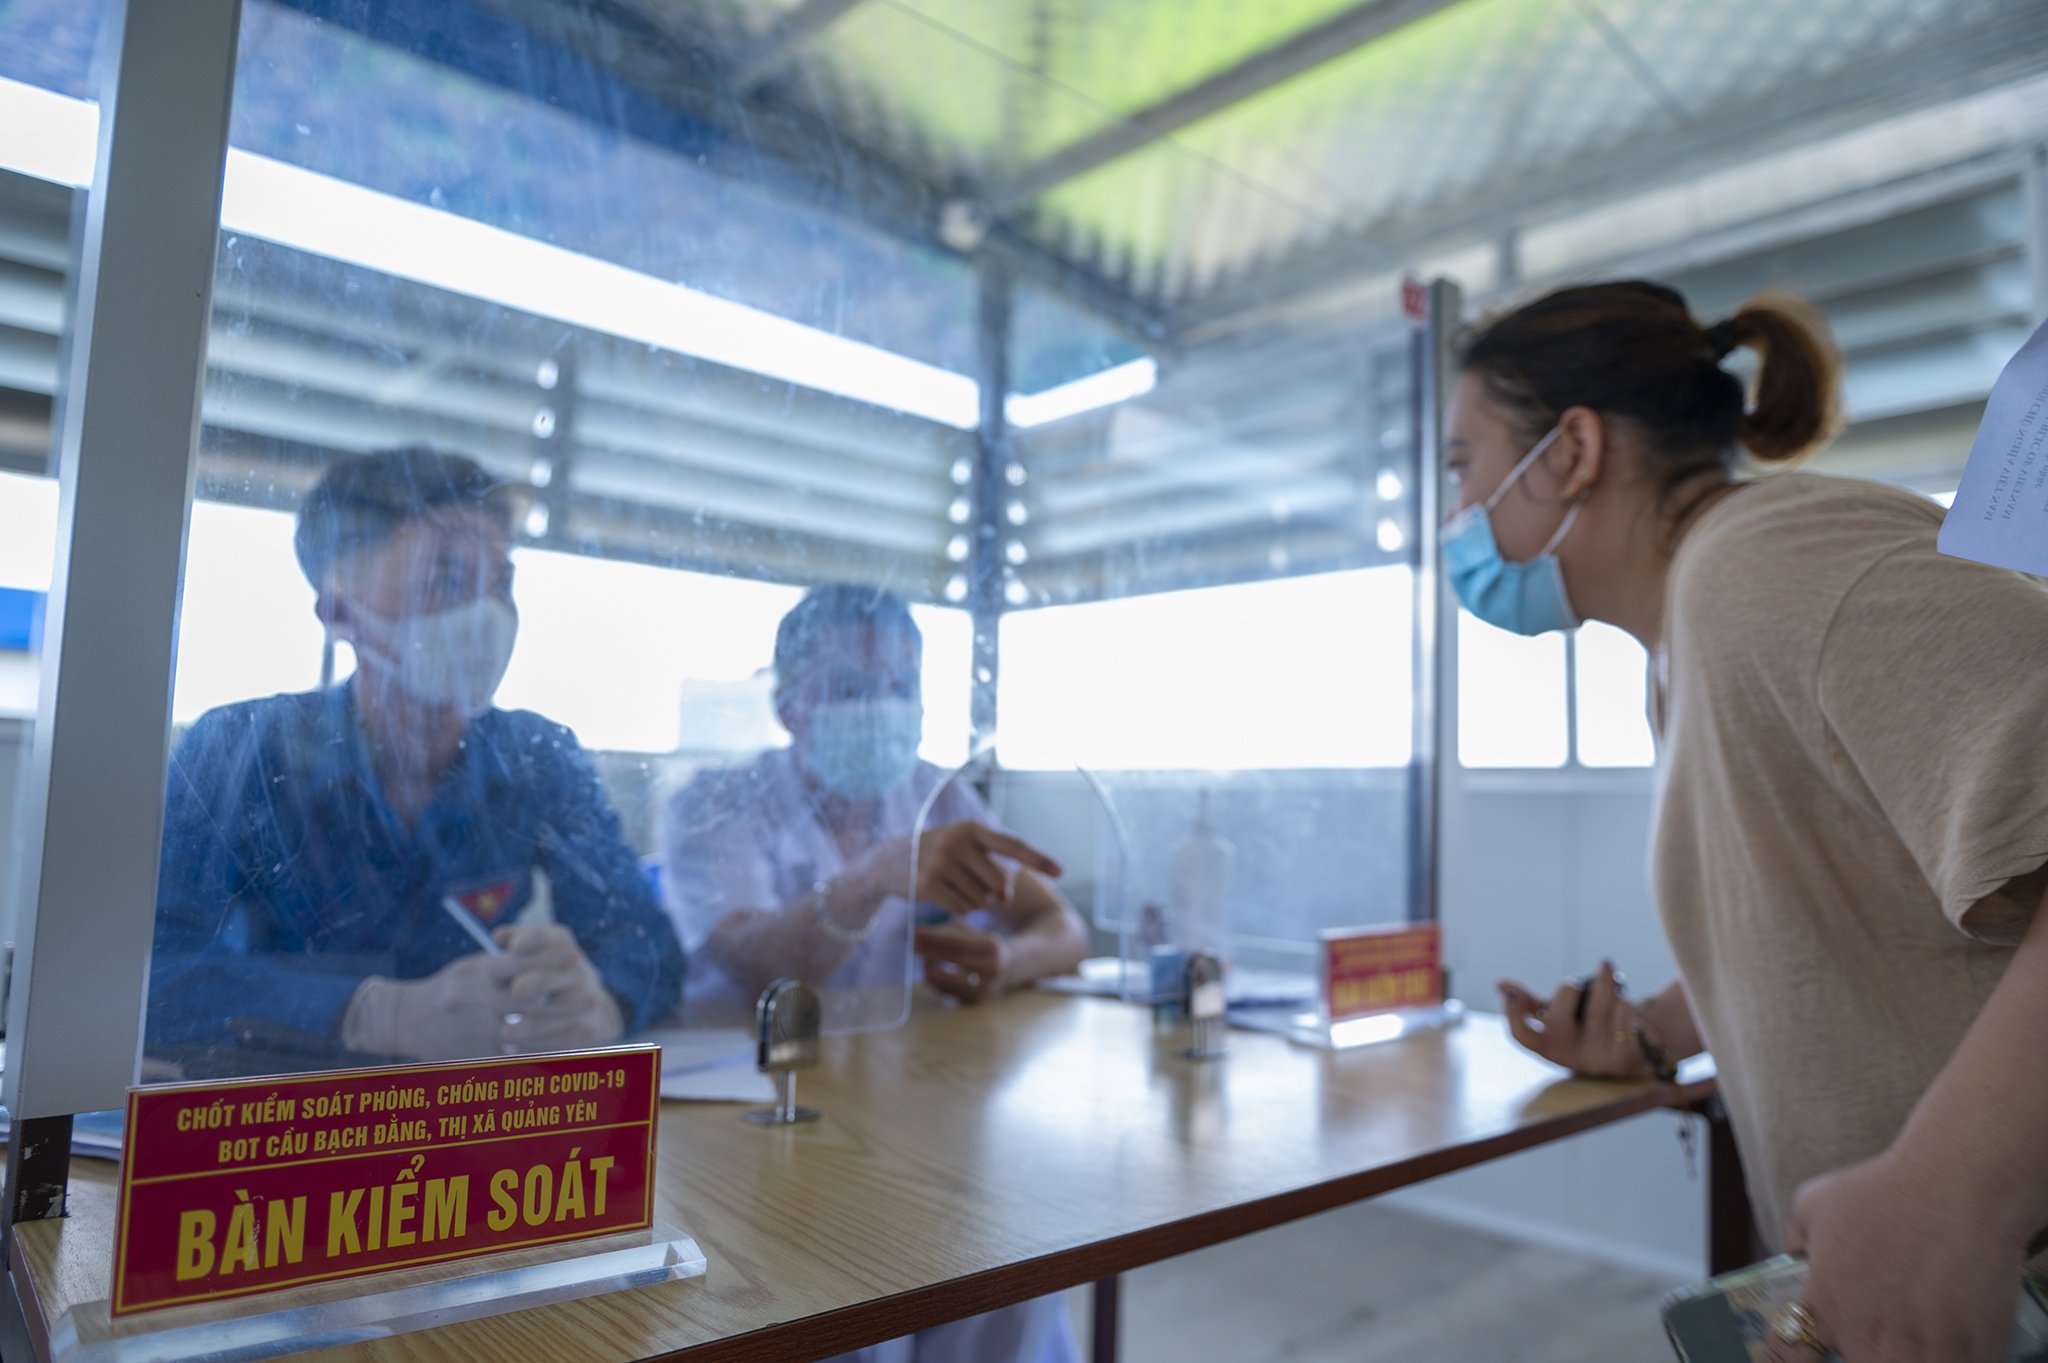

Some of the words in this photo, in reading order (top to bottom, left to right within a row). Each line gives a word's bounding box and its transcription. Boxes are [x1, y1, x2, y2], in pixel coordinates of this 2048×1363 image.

[177, 1098, 235, 1132] CHỐT
[240, 1092, 296, 1125] KIỂM
[301, 1090, 354, 1120] SOÁT
[359, 1085, 431, 1113] PHÒNG,
[437, 1076, 499, 1106] CHỐNG
[504, 1076, 545, 1102] DỊCH
[550, 1069, 625, 1094] COVID-19
[218, 1137, 260, 1163] BOT
[265, 1127, 309, 1158] CẦU
[314, 1125, 368, 1154] BẠCH
[373, 1113, 432, 1145] ĐẰNG,
[438, 1115, 467, 1140] THỊ
[472, 1109, 496, 1134] XÃ
[501, 1100, 560, 1132] QUẢNG
[565, 1099, 598, 1122] YÊN
[176, 1189, 307, 1282] BÀN
[326, 1154, 471, 1259] KIỂM
[487, 1147, 615, 1232] SOÁT
